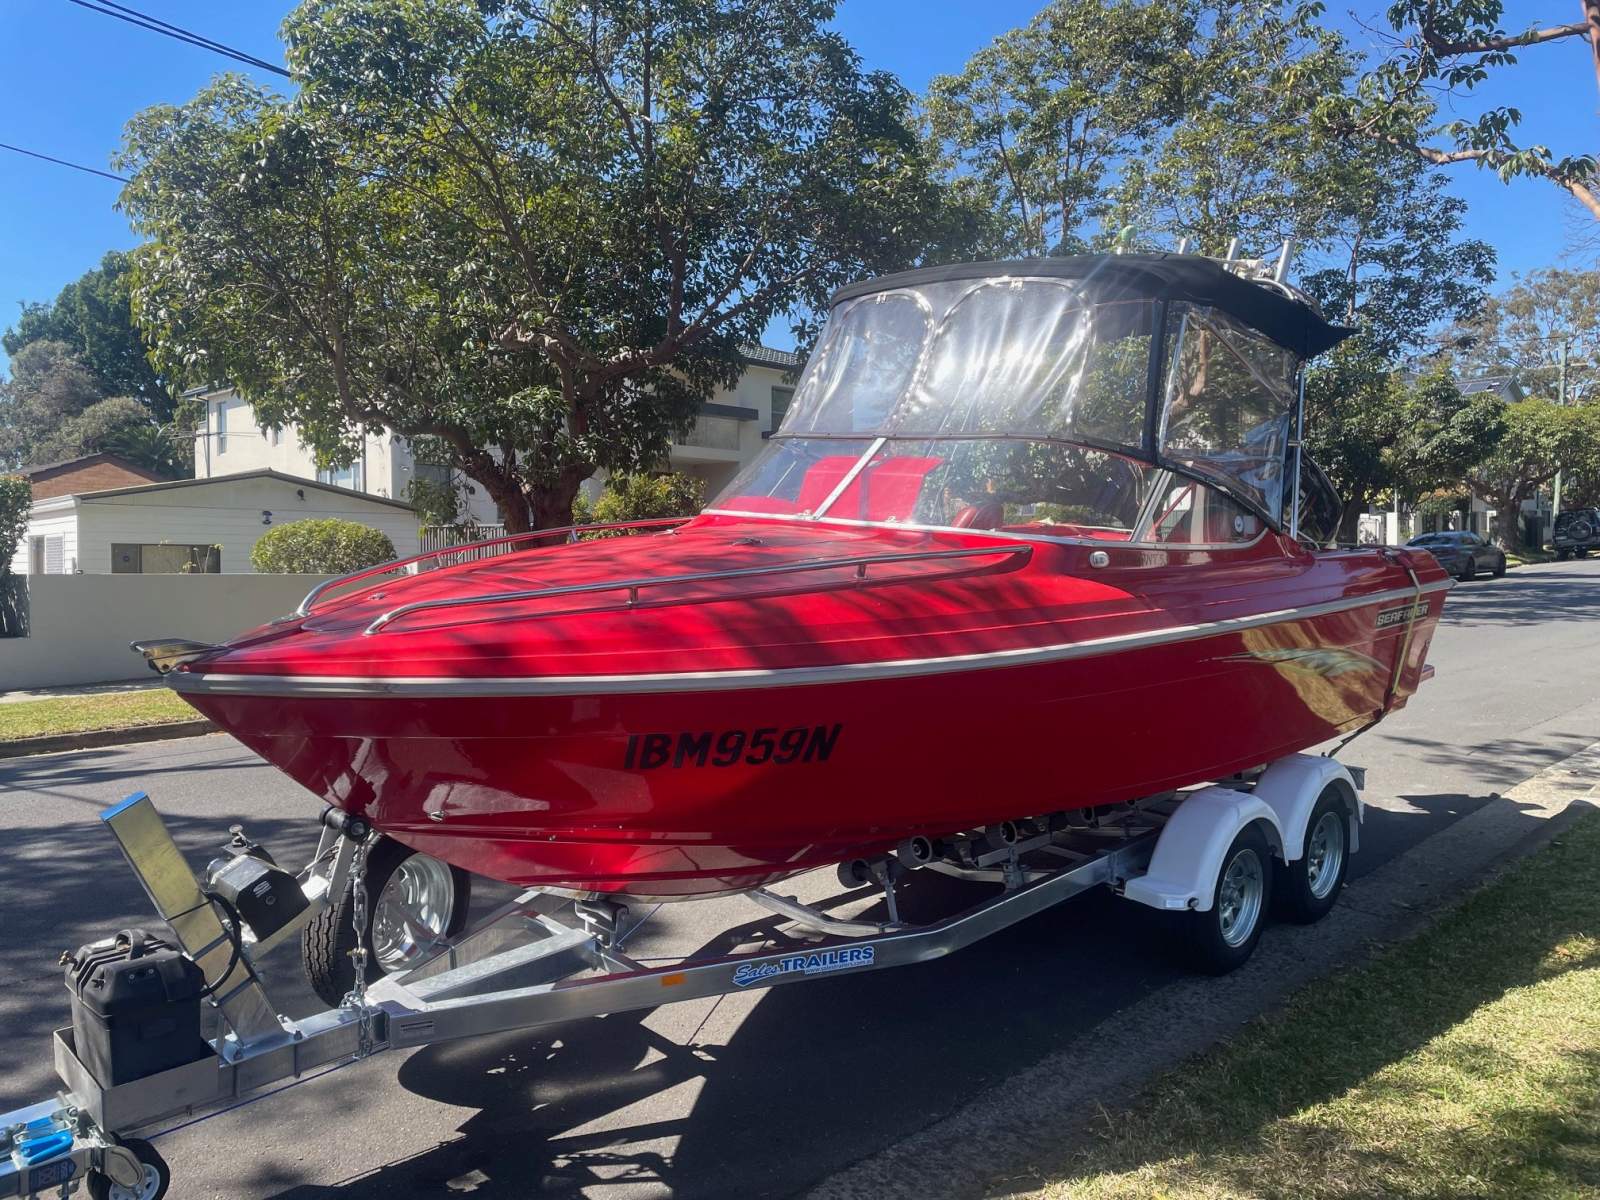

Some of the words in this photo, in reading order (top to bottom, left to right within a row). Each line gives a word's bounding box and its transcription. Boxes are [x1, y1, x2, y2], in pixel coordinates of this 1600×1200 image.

[624, 723, 843, 769] IBM959N
[733, 963, 780, 981] Sales
[781, 947, 875, 972] TRAILERS
